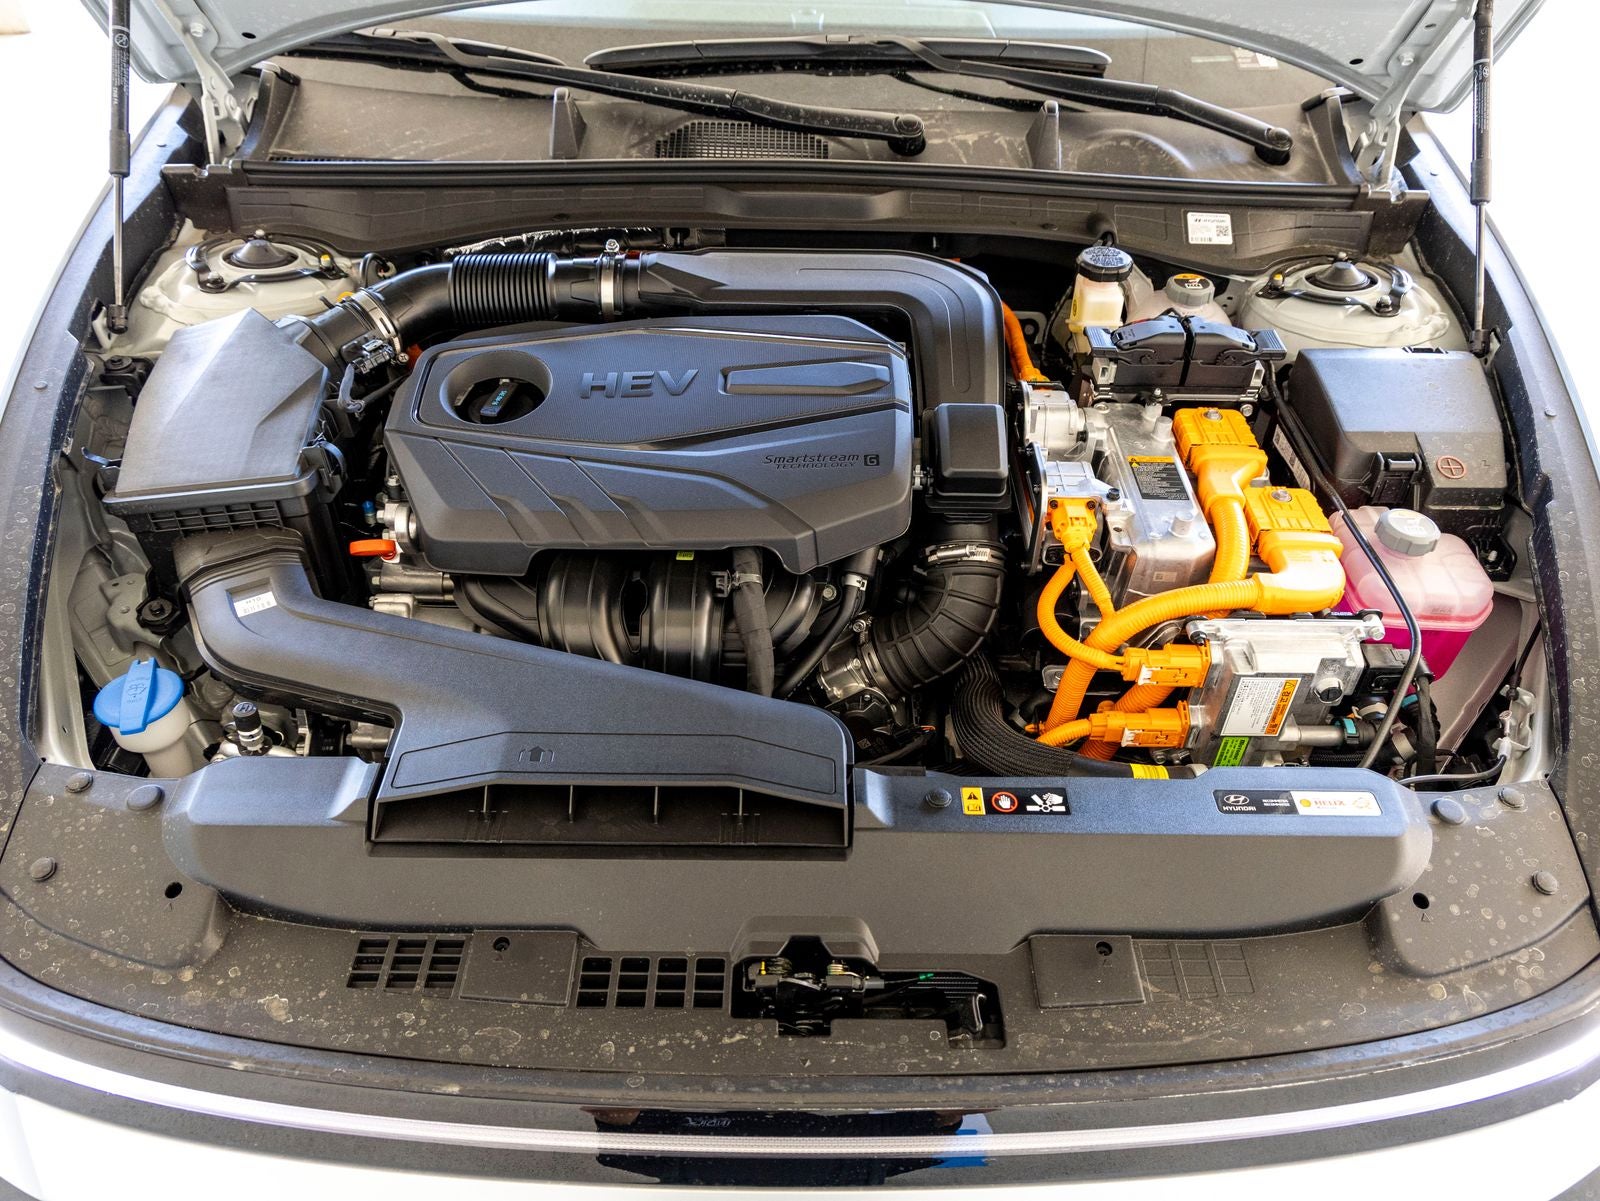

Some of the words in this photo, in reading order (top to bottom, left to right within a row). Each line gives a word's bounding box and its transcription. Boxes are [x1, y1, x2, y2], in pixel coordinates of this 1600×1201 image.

[580, 368, 699, 399] HEV
[763, 454, 859, 464] Smartstream
[864, 454, 880, 467] G
[775, 462, 856, 470] TECHNOLOGY
